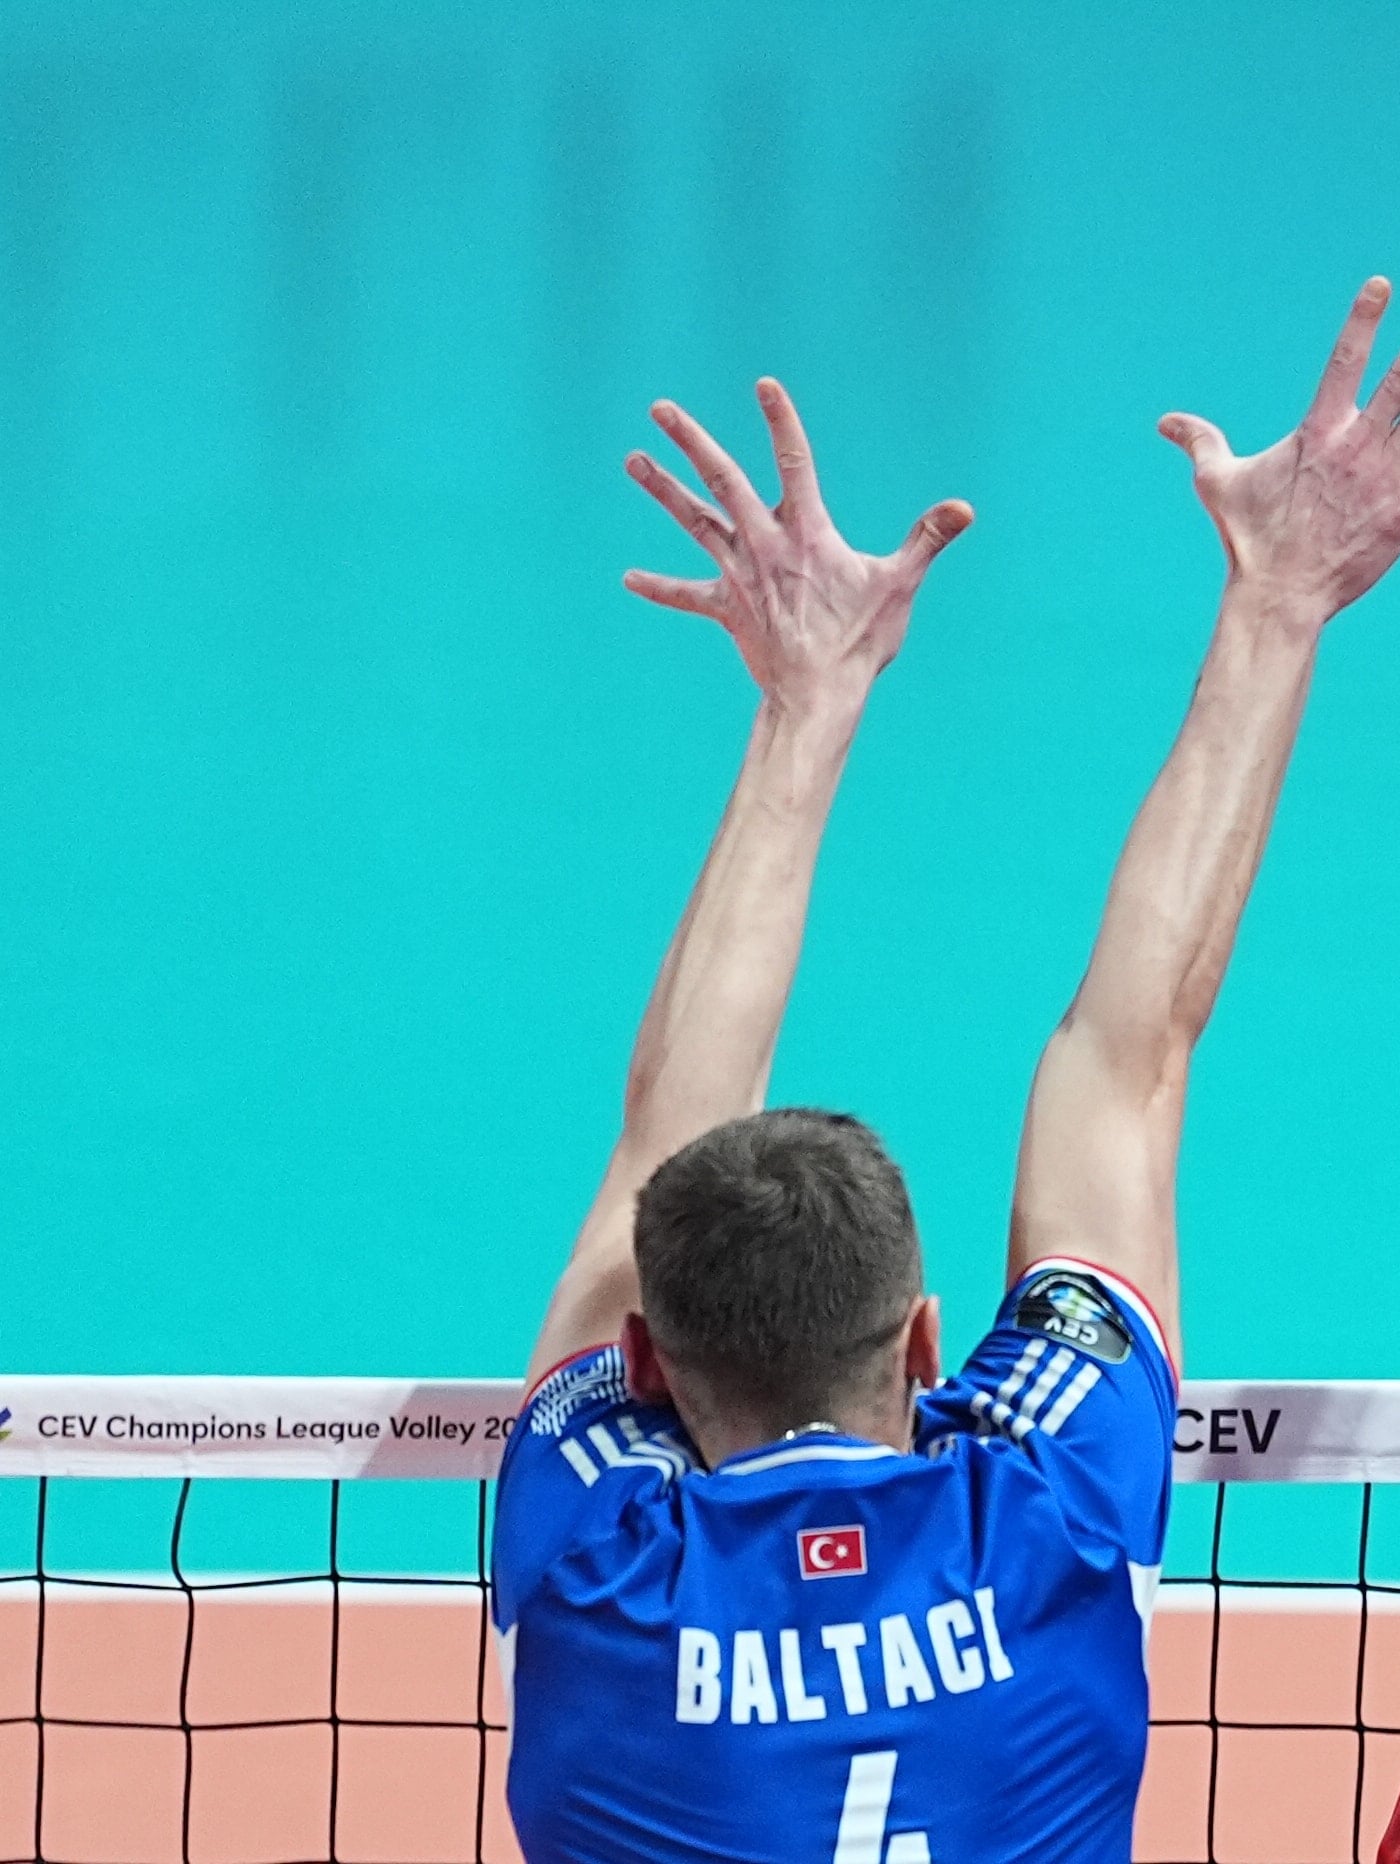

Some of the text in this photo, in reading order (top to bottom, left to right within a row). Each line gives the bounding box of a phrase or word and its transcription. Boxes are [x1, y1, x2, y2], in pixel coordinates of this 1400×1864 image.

[1044, 1316, 1099, 1345] CEV
[38, 1414, 518, 1445] CEV Champions League Volley 20
[1172, 1408, 1281, 1454] CEV
[676, 1586, 1015, 1725] BALTACI
